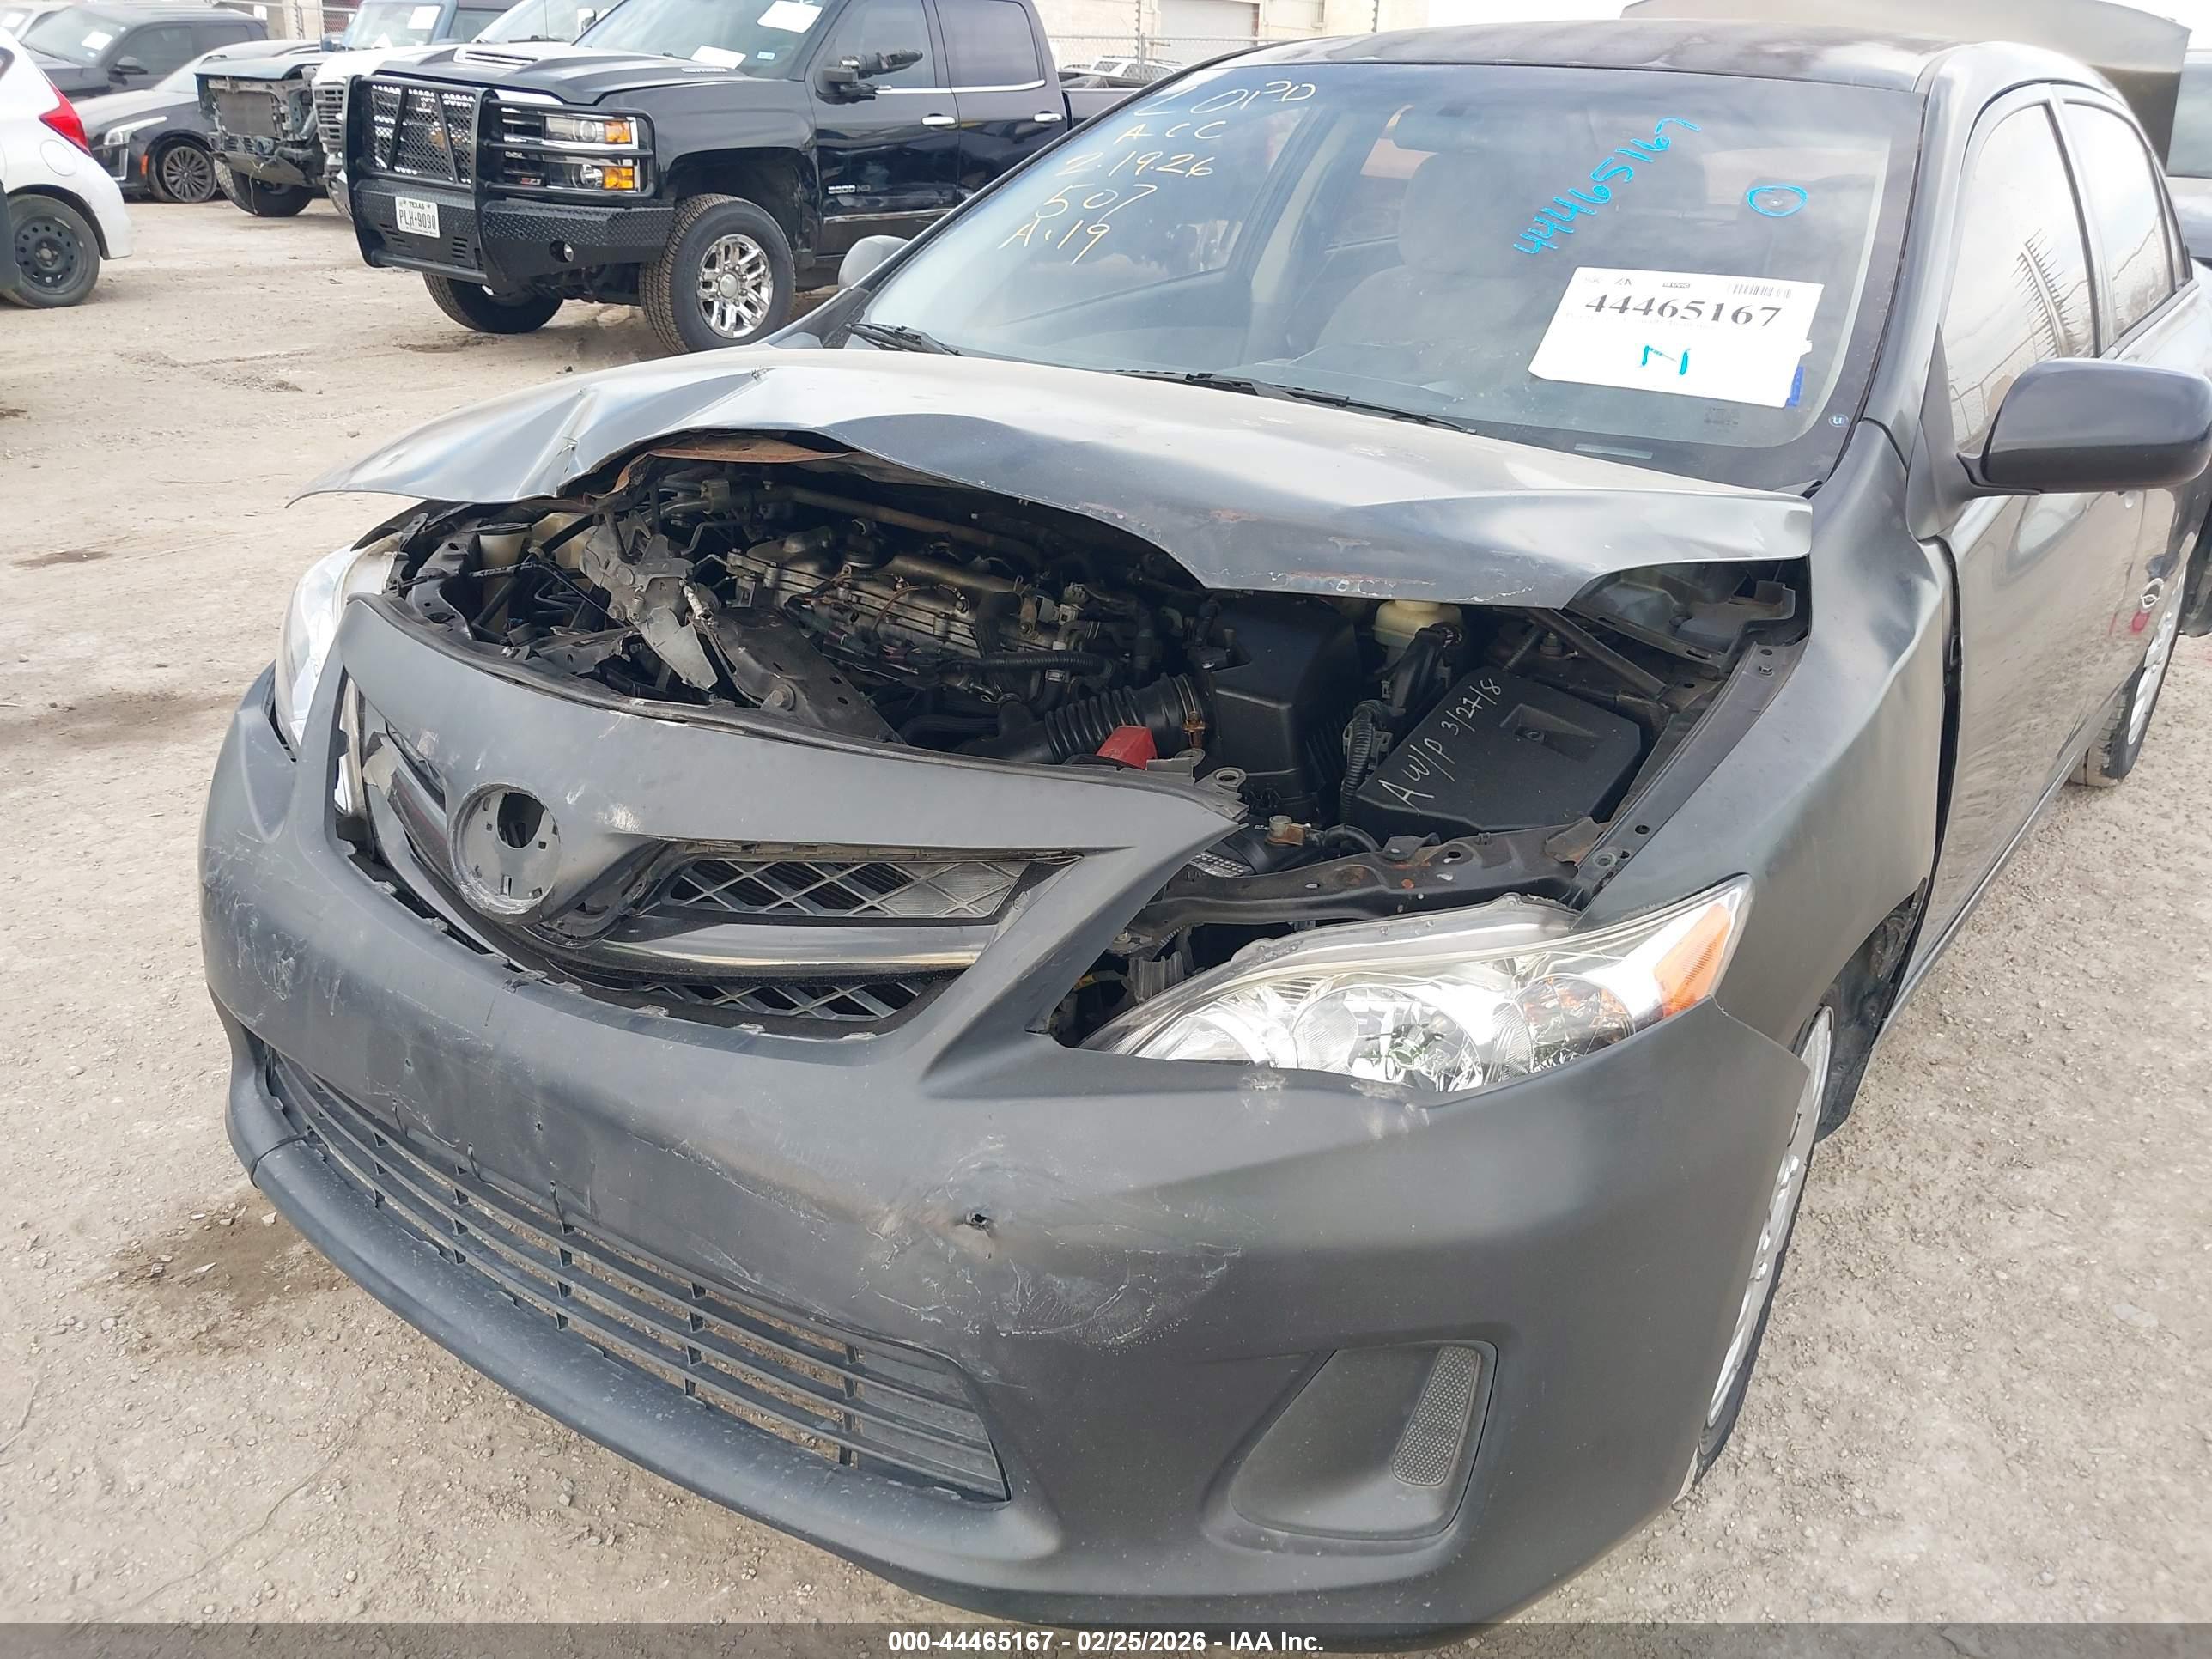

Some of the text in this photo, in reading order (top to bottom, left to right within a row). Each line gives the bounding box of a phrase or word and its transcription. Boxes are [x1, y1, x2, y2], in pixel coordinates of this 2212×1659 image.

[1113, 120, 1227, 145] ACC
[1512, 116, 1702, 254] 44465167
[408, 200, 425, 210] TEXAS
[1035, 183, 1158, 225] 507
[1584, 293, 1783, 327] 44465167
[1377, 778, 1435, 813] A
